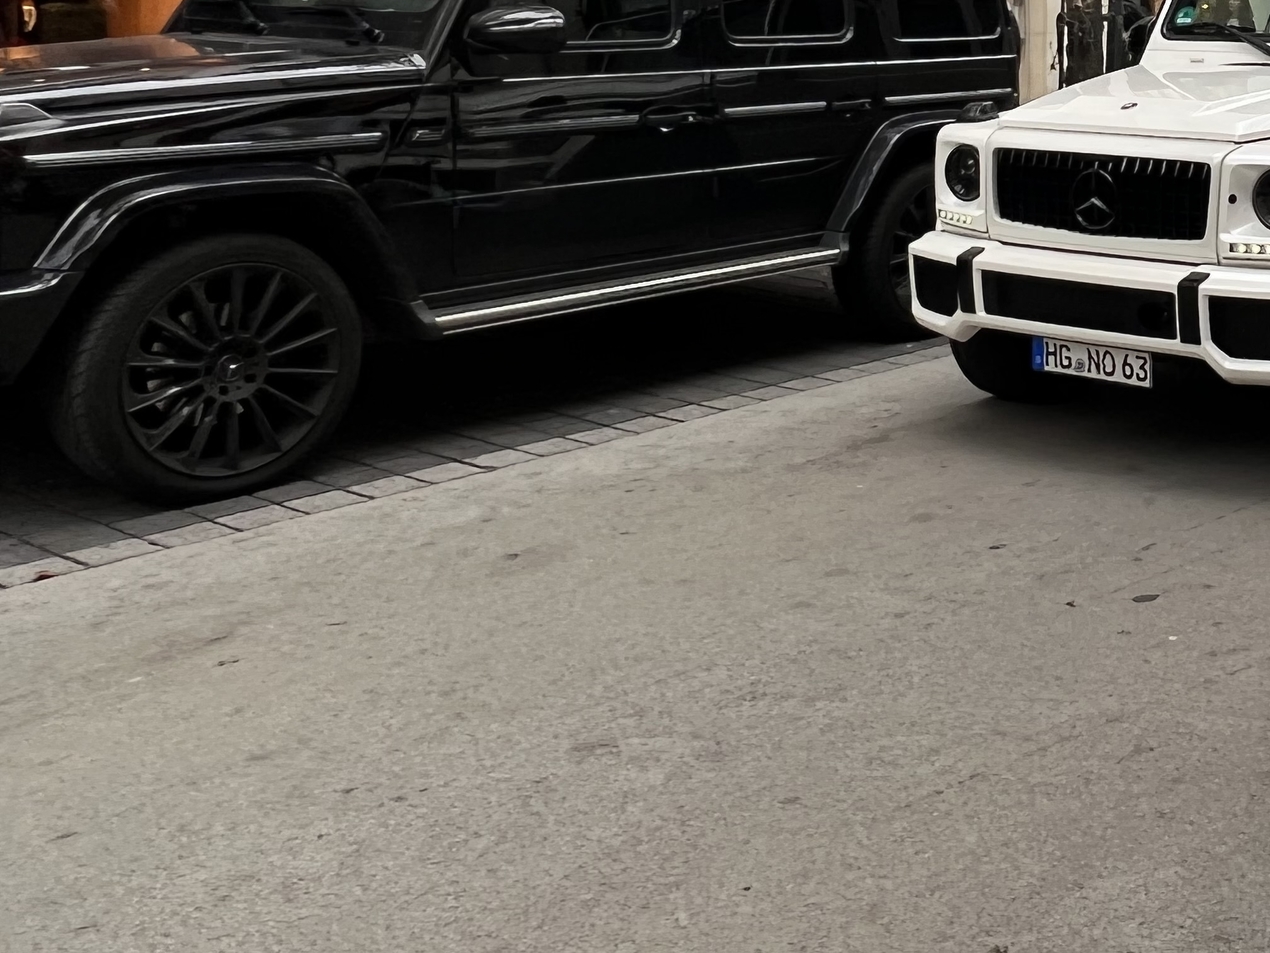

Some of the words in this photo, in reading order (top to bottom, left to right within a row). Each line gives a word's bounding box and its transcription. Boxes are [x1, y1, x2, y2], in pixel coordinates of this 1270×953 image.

[1044, 341, 1073, 370] HG
[1086, 347, 1117, 377] NO
[1121, 354, 1149, 382] 63
